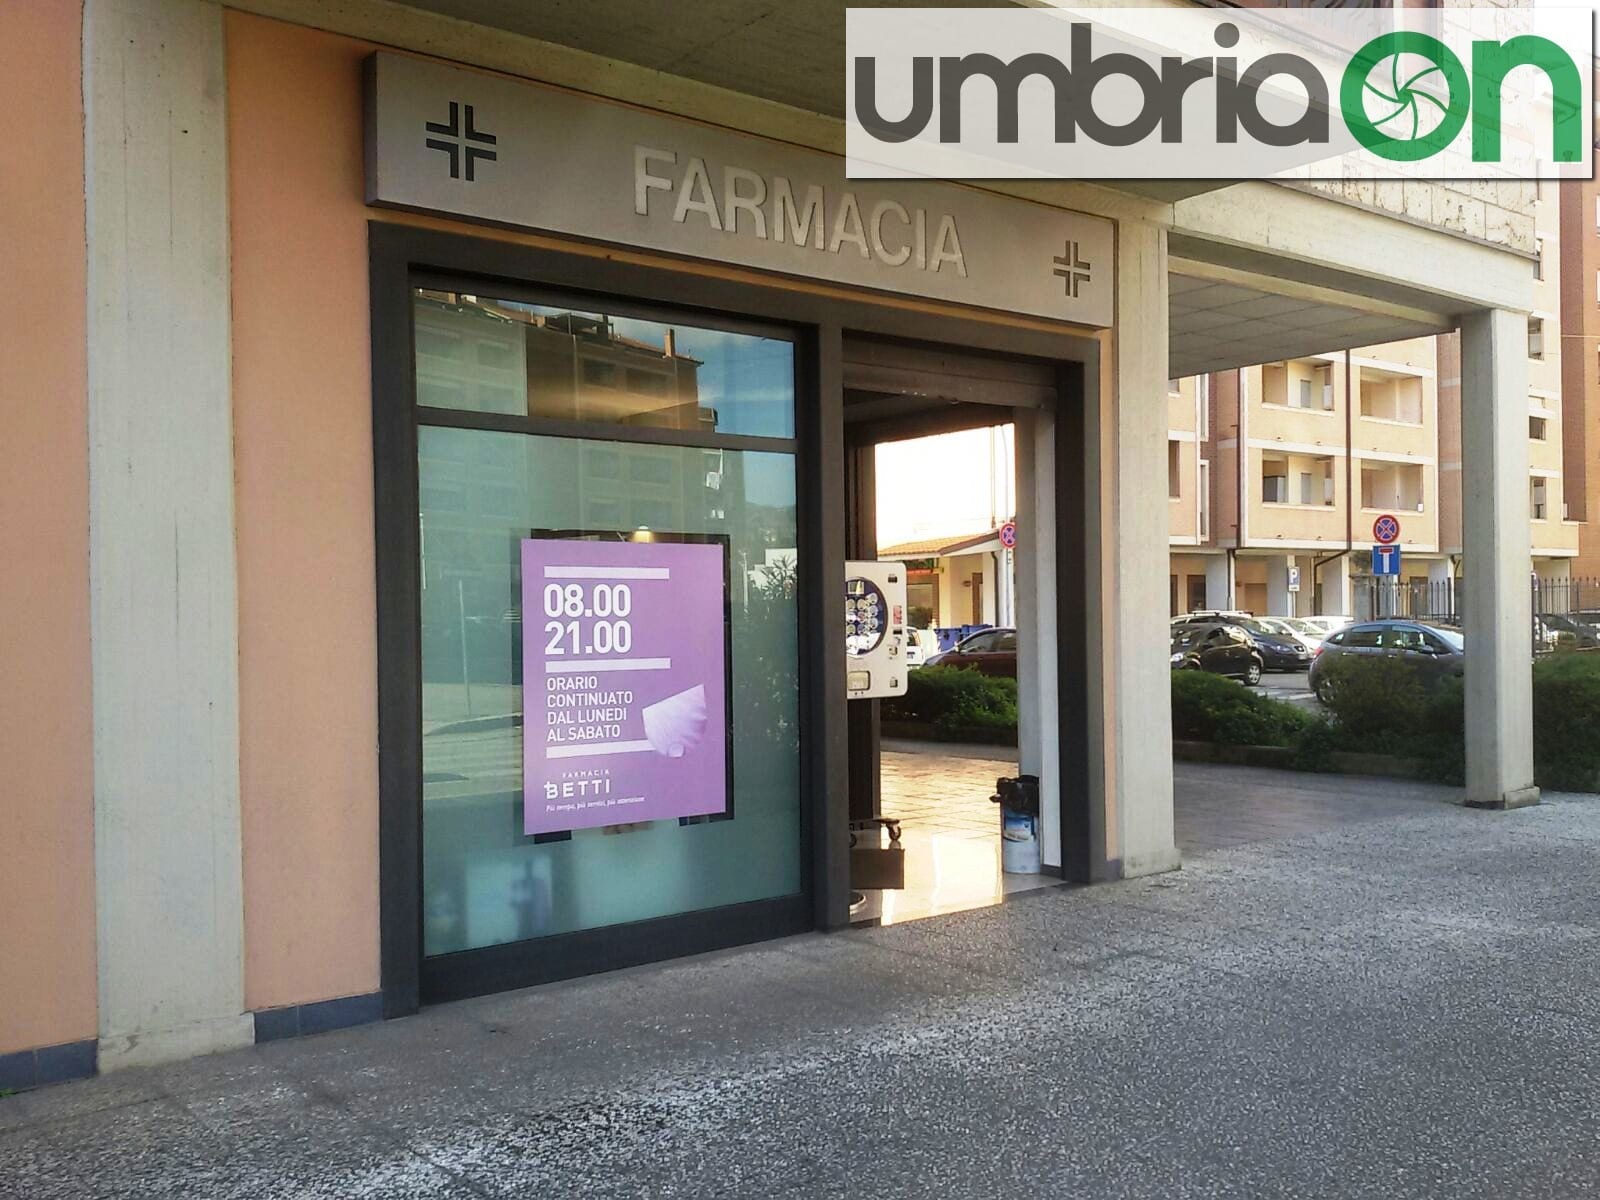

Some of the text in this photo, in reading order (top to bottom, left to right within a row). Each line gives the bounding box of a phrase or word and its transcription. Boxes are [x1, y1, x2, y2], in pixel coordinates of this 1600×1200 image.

[632, 144, 969, 278] FARMACIA
[543, 583, 632, 618] 08.00
[544, 620, 632, 655] 21.00
[546, 675, 598, 691] ORARIO
[547, 690, 633, 708] CONTINUATO
[547, 707, 627, 725] DAL LUNEDI
[547, 724, 621, 742] AL SABATO
[543, 778, 610, 799] BETTI
